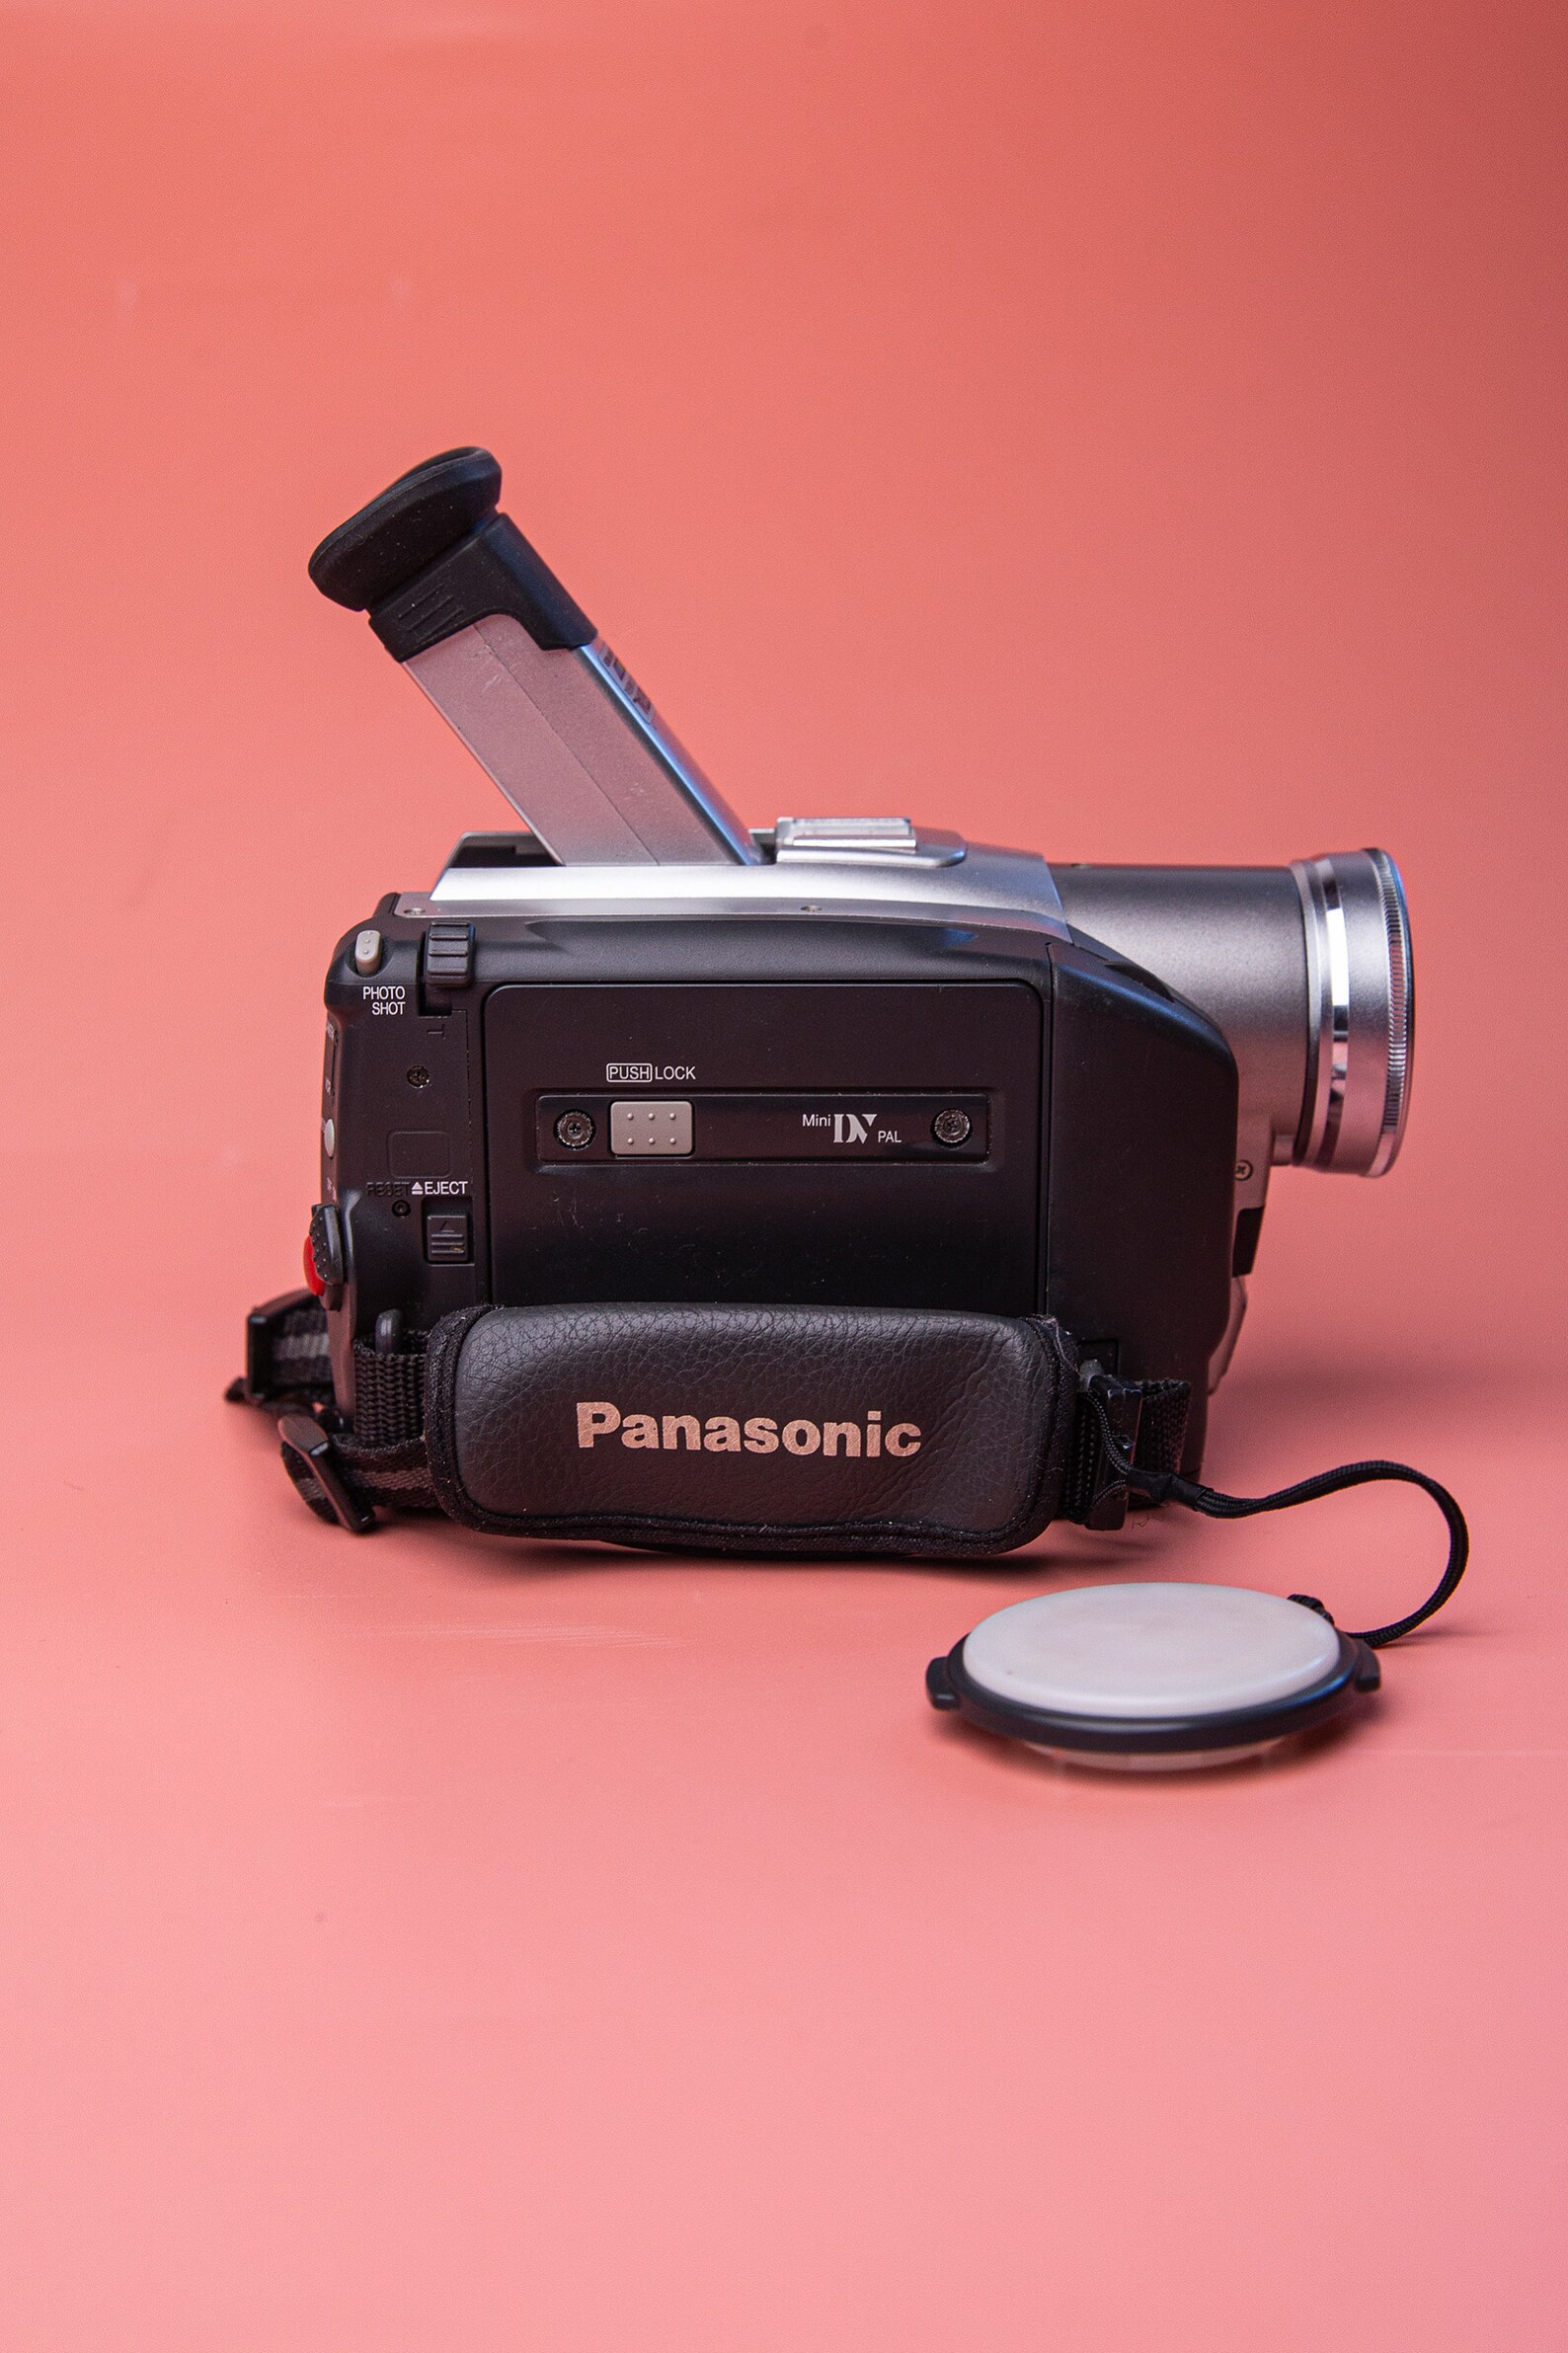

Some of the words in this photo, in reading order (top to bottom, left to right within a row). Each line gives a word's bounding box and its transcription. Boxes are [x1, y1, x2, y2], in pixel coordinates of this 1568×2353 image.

[362, 985, 406, 1001] PHOTO
[371, 1001, 406, 1016] SHOT
[608, 1065, 651, 1081] PUSH
[654, 1065, 696, 1081] LOCK
[802, 1113, 831, 1128] Mini
[832, 1113, 878, 1144] DV
[878, 1130, 902, 1144] PAL
[365, 1181, 411, 1197] RESET
[424, 1181, 469, 1196] EJECT
[576, 1401, 922, 1458] Panasonic
